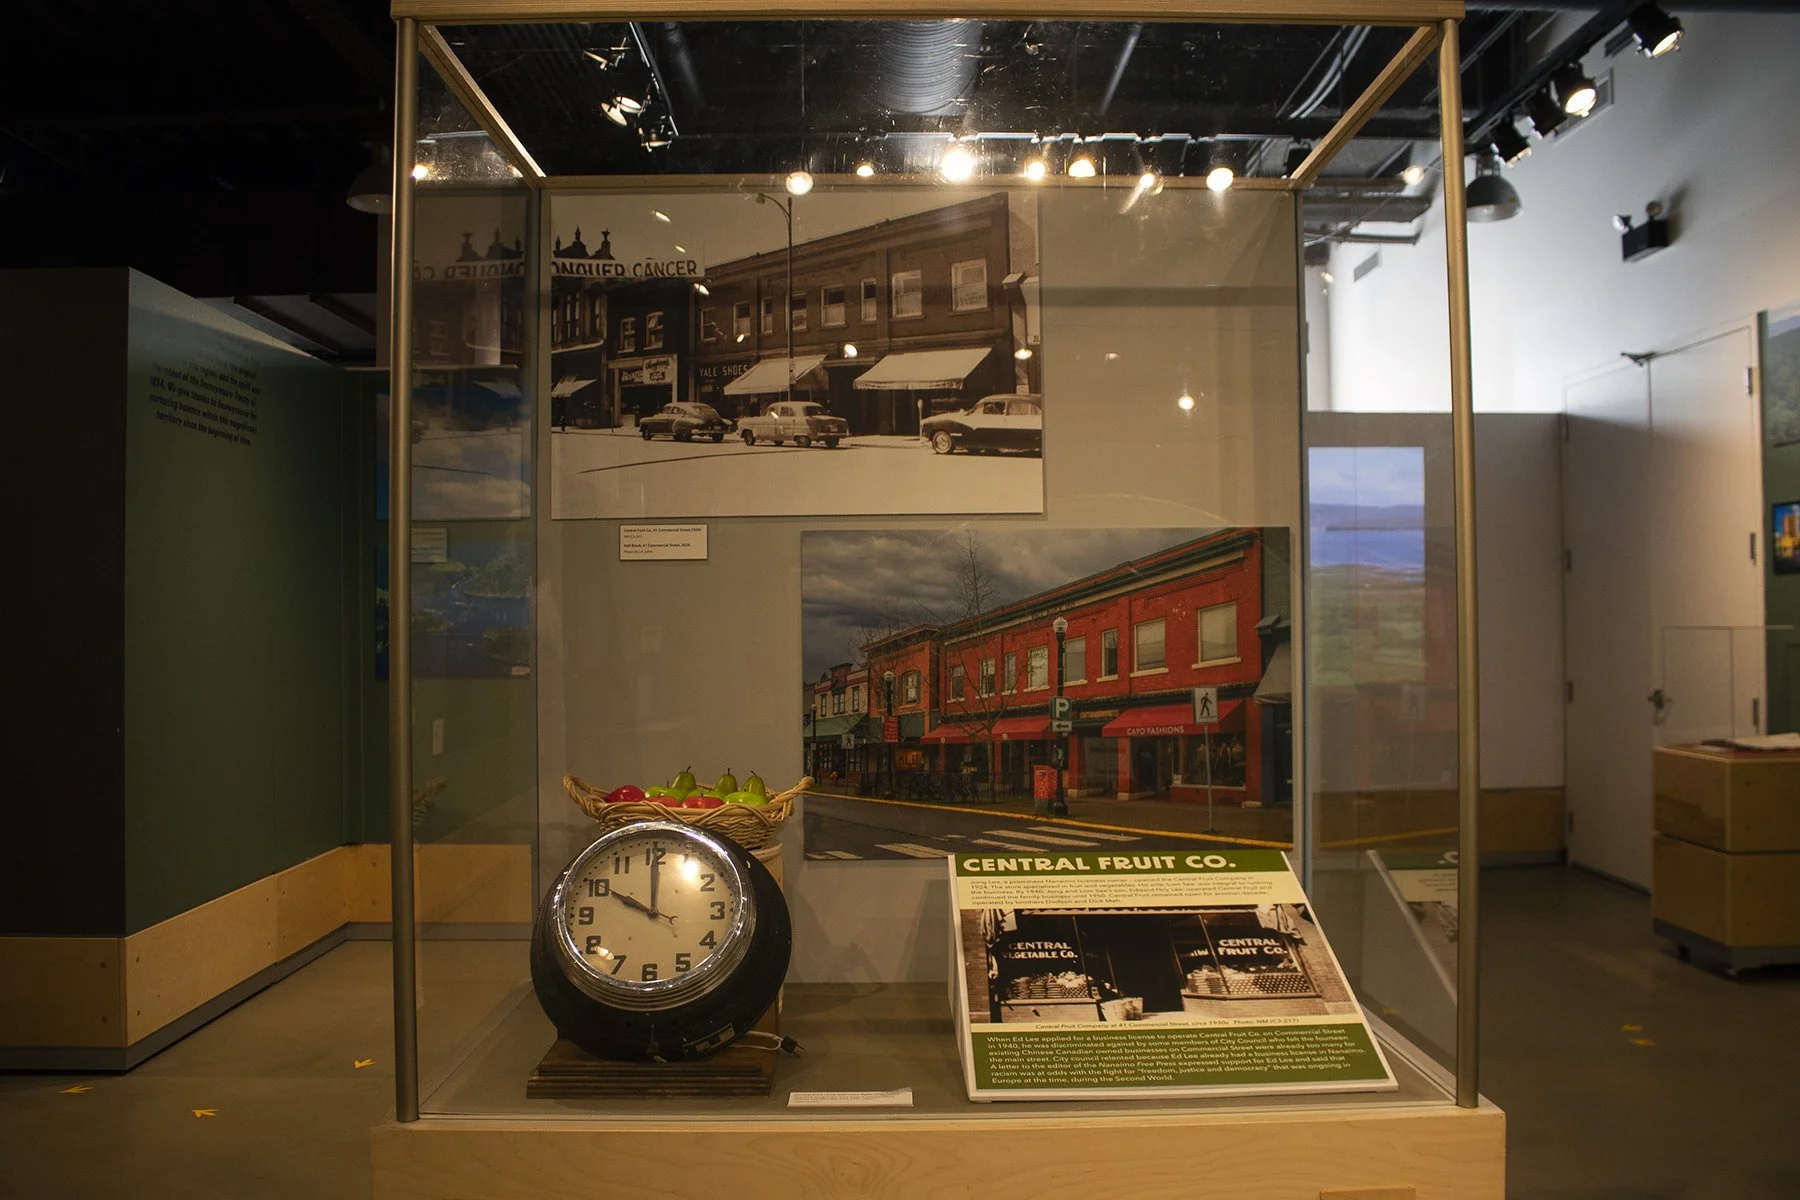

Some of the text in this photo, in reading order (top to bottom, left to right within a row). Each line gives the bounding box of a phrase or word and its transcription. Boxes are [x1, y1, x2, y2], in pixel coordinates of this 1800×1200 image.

[633, 260, 696, 277] CANCER
[700, 364, 748, 376] YALE SHOES
[1056, 698, 1069, 718] P
[1126, 726, 1184, 736] CAYO FASHIONS
[615, 856, 630, 874] 11
[645, 848, 666, 866] 12
[962, 854, 1237, 872] CENTRAL FRUIT CO.
[589, 879, 610, 897] 10
[700, 874, 715, 892] 2
[579, 906, 594, 925] 9
[710, 902, 725, 920] 3
[586, 936, 601, 954] 8
[699, 930, 717, 949] 4
[1008, 942, 1072, 950] CENTRAL
[1219, 938, 1280, 946] CENTRAL
[1218, 947, 1258, 955] FRUIT
[611, 955, 626, 975] 7
[676, 953, 691, 972] 5
[642, 964, 658, 982] 6
[1106, 1040, 1134, 1048] against
[1167, 1032, 1197, 1040] operate
[1052, 1055, 1068, 1063] City
[1178, 1059, 1218, 1067] expressed
[1220, 1058, 1251, 1066] support
[1103, 1068, 1121, 1076] fight
[1308, 1063, 1341, 1071] ongoing
[992, 1077, 1021, 1085] Europe
